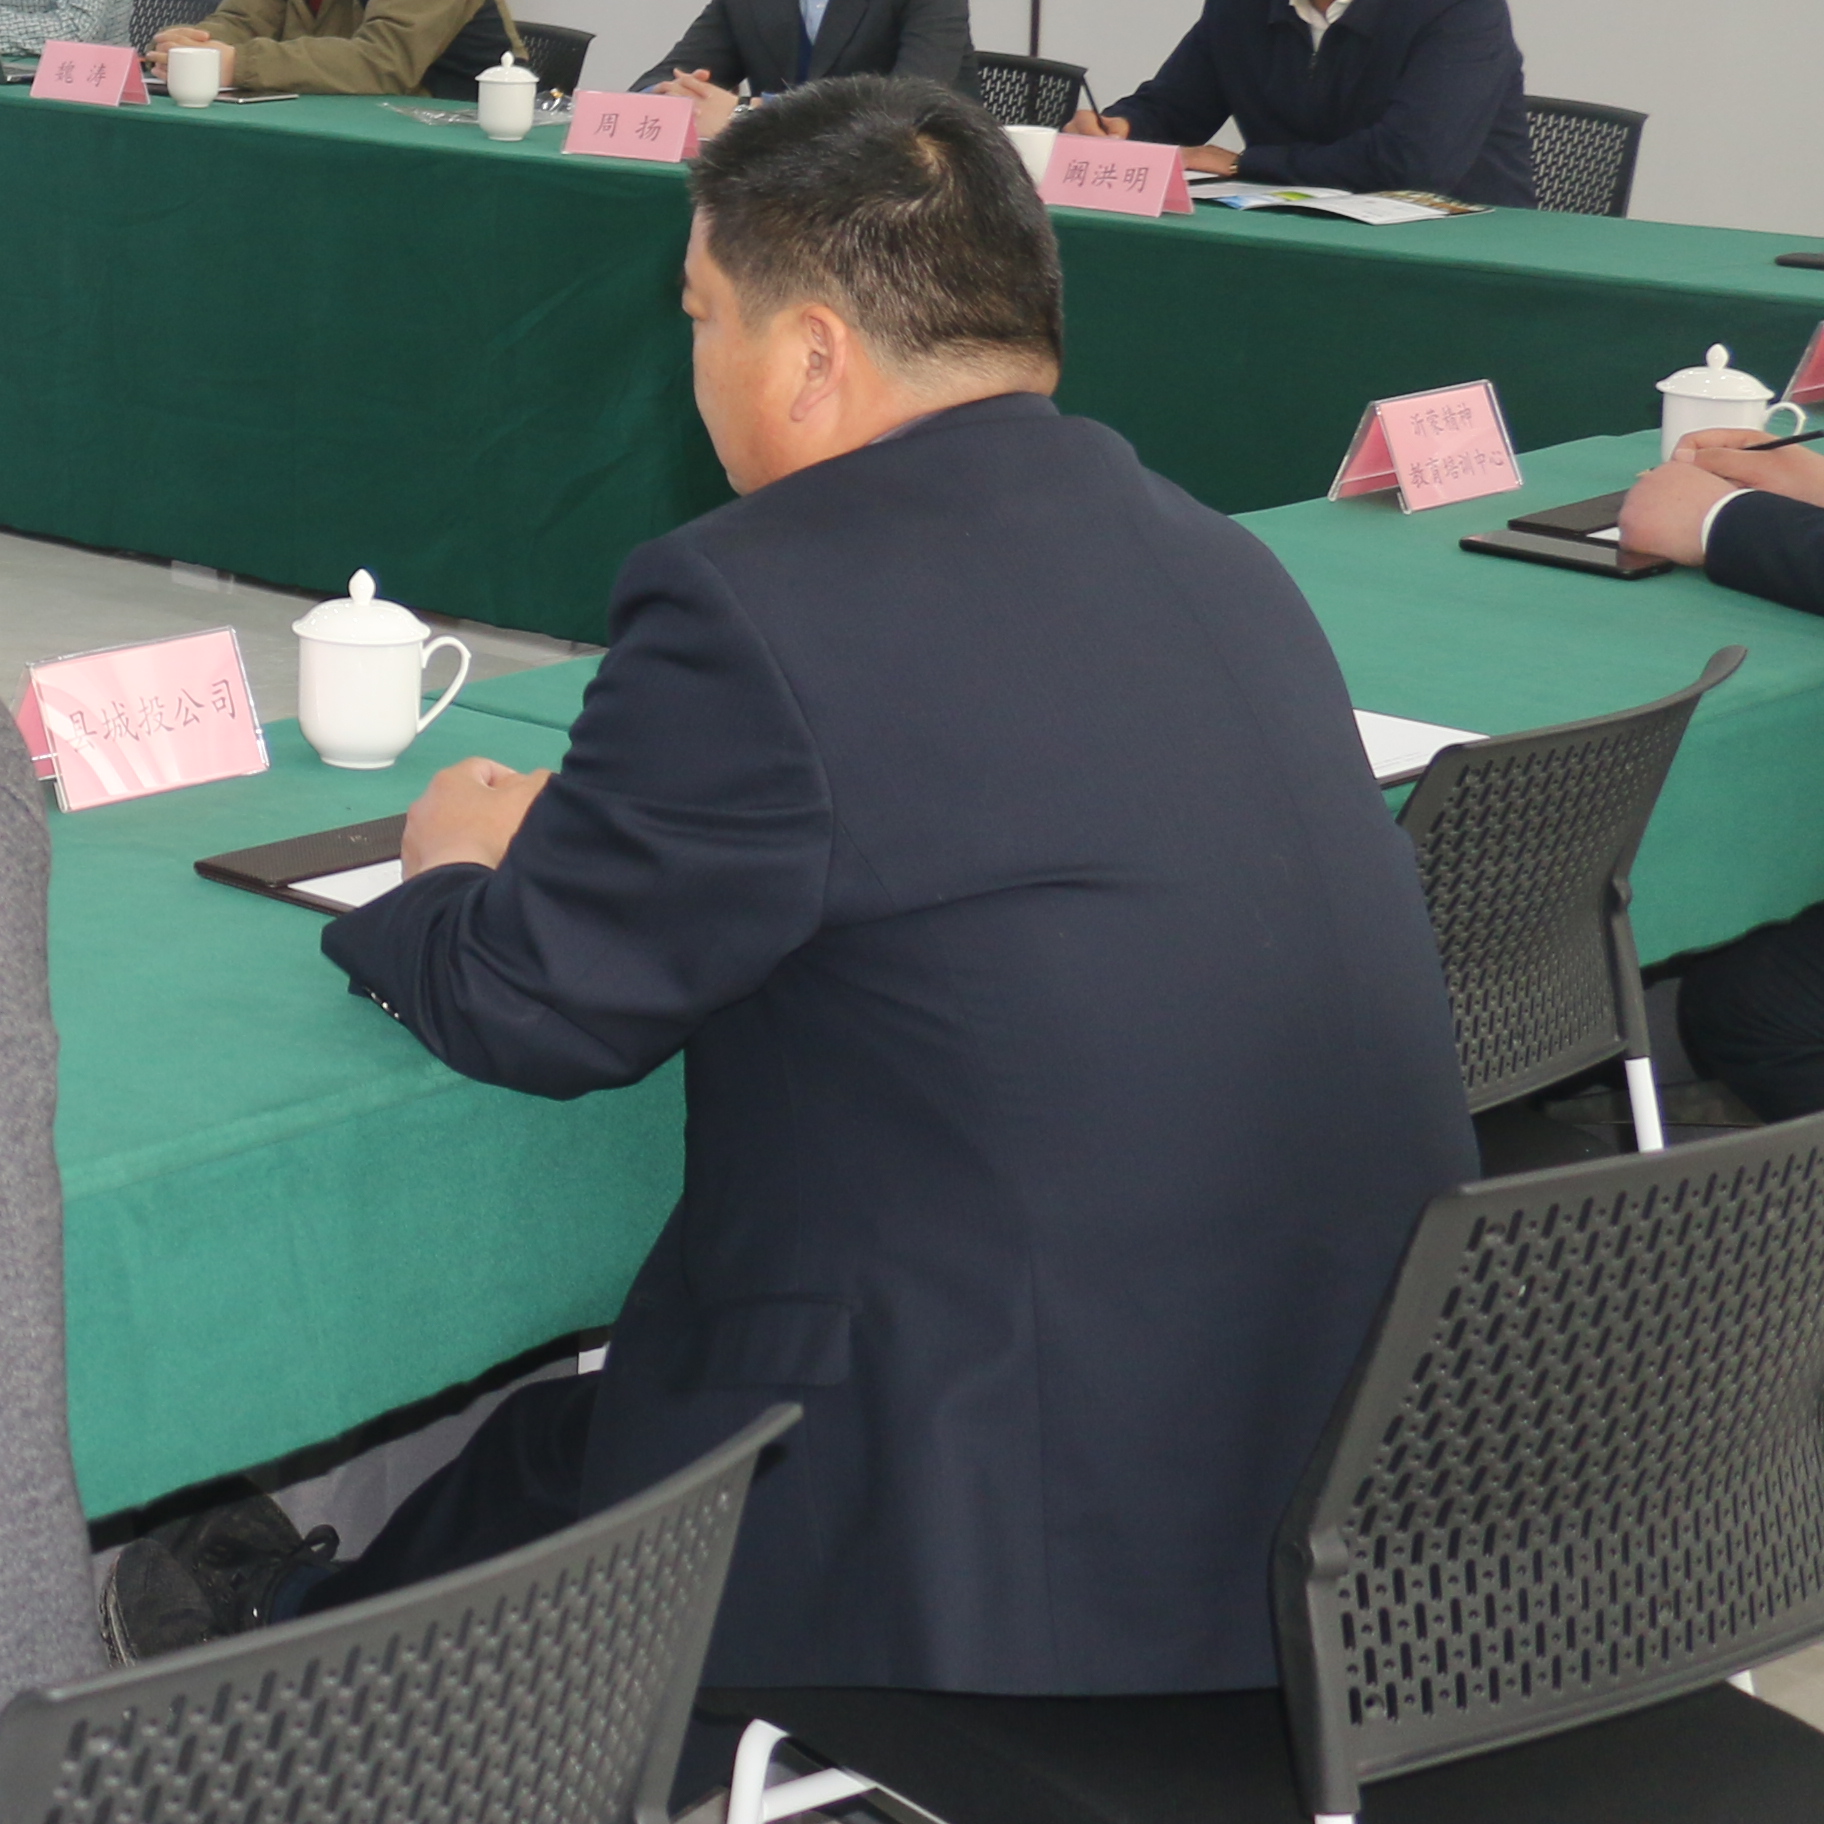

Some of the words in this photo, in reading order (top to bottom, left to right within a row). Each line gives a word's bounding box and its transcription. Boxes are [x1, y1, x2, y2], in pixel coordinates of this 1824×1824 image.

[1408, 447, 1505, 489] 教育培训中心
[66, 677, 237, 754] 县城投公司
